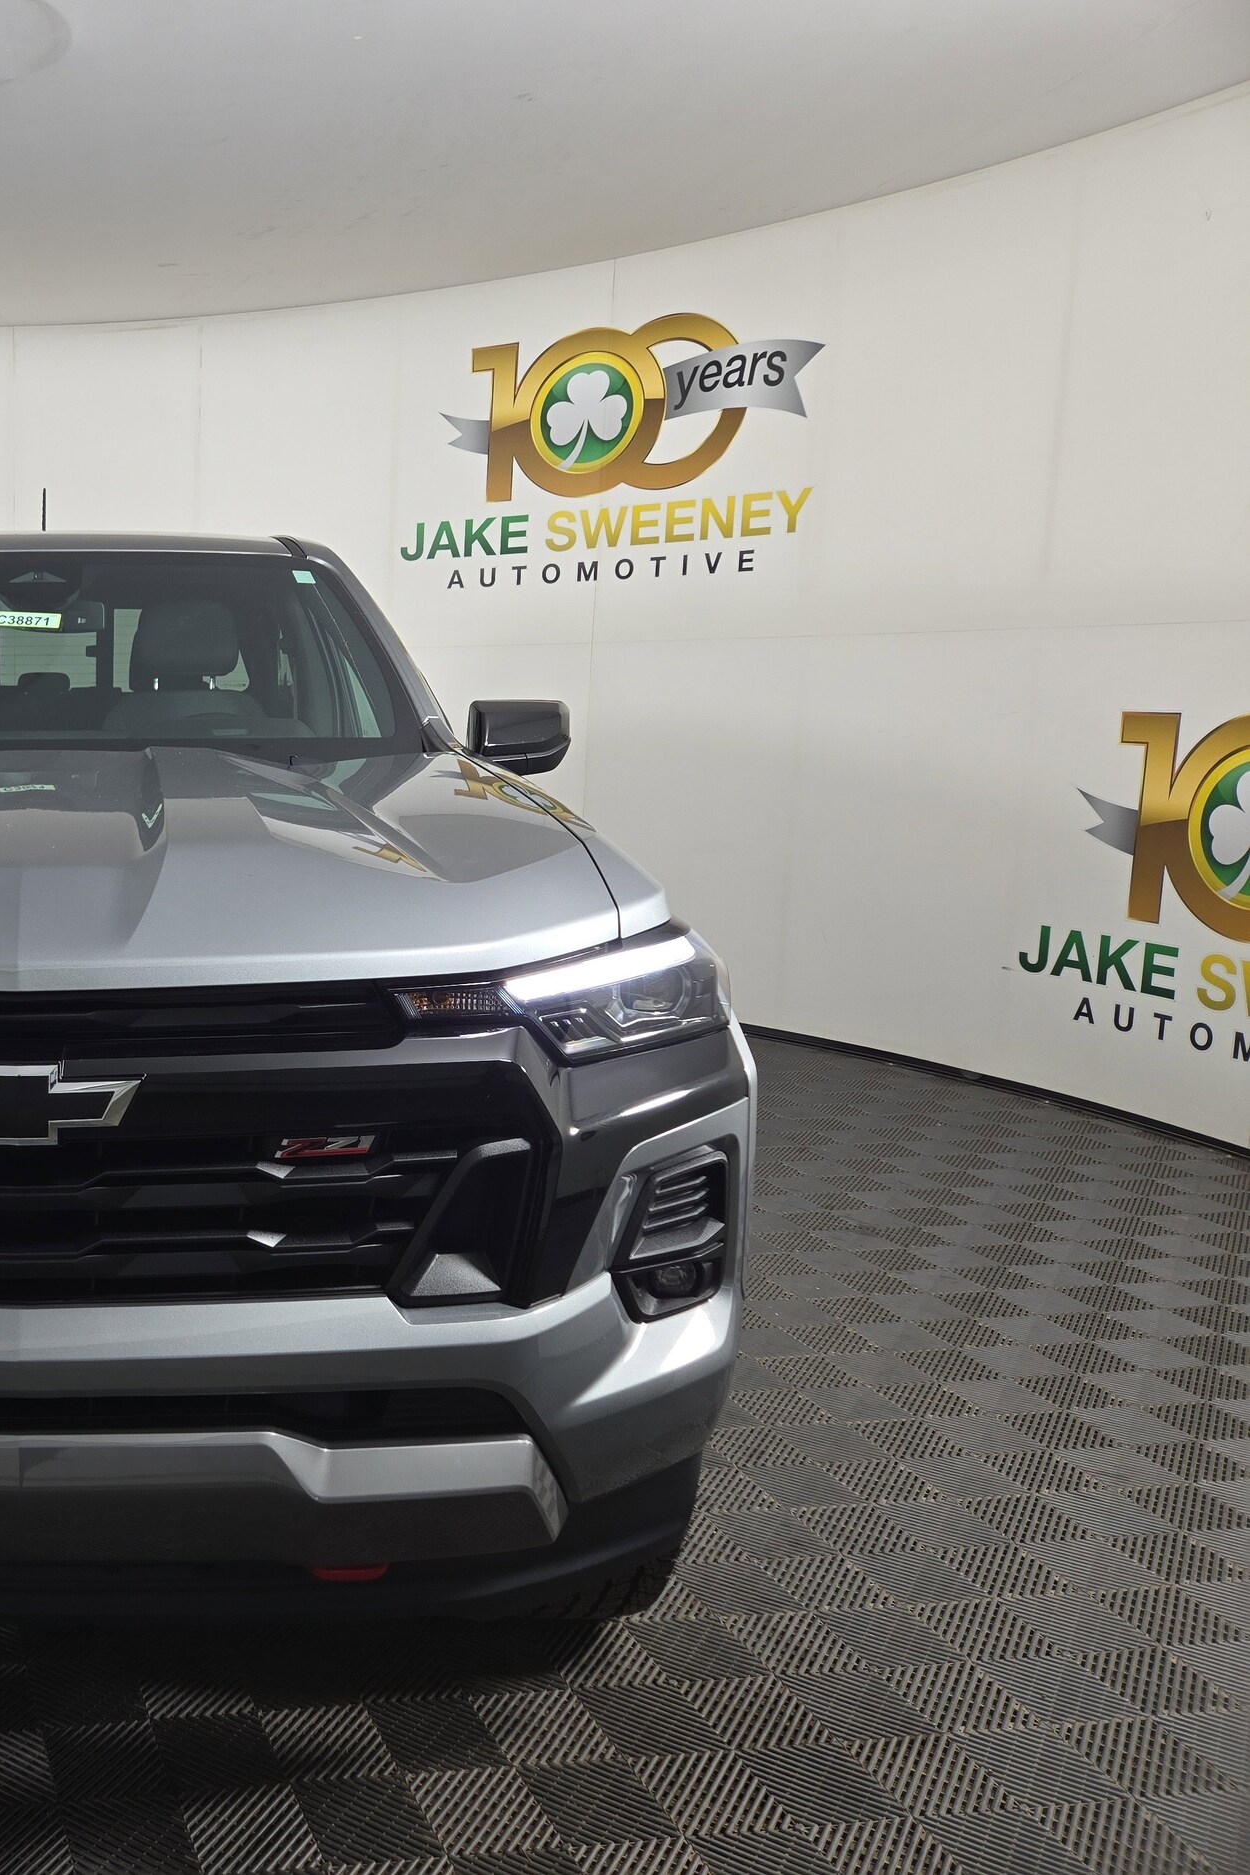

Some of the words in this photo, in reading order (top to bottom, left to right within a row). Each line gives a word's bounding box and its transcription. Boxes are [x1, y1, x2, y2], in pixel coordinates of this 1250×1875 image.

[673, 350, 787, 410] years
[400, 514, 529, 561] JAKE
[545, 487, 813, 552] SWEENEY
[447, 549, 755, 590] AUTOMOTIVE
[1019, 925, 1179, 1000] JAKE
[274, 1135, 376, 1158] Z71
